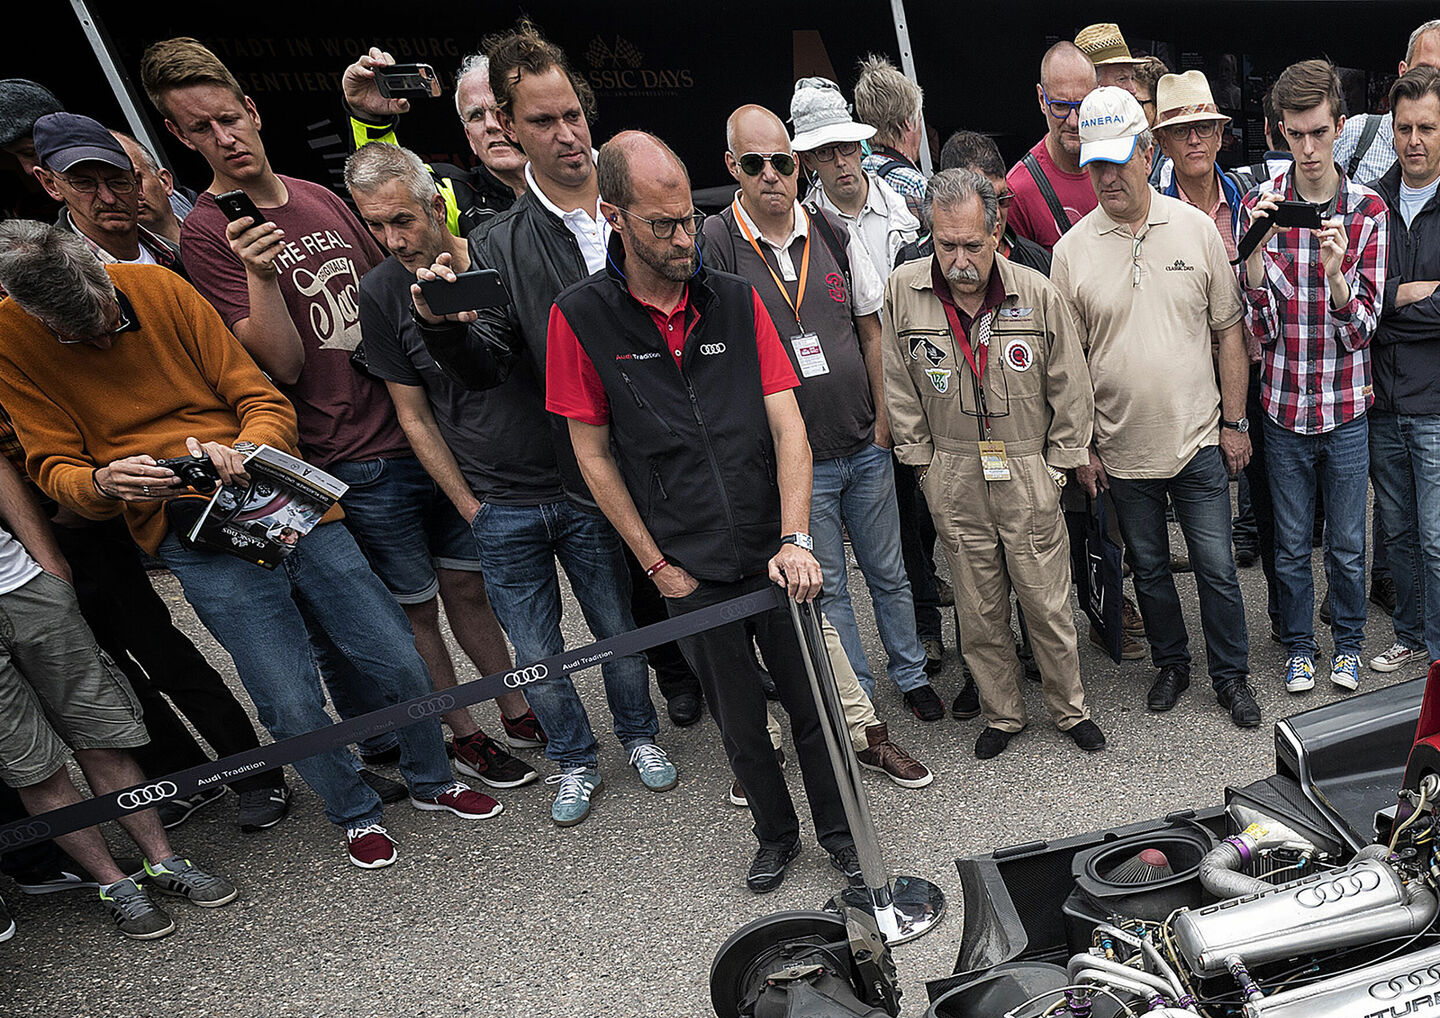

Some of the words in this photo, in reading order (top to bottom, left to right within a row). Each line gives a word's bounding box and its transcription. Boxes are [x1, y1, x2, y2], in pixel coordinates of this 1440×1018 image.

[287, 37, 313, 57] IN
[640, 68, 695, 89] DAYS
[1080, 114, 1125, 129] PANERAI
[300, 230, 353, 255] REAL
[632, 351, 661, 360] Tradition
[562, 659, 580, 670] Audi
[580, 650, 613, 664] Tradition
[197, 773, 222, 786] Audi
[221, 760, 266, 777] Tradition
